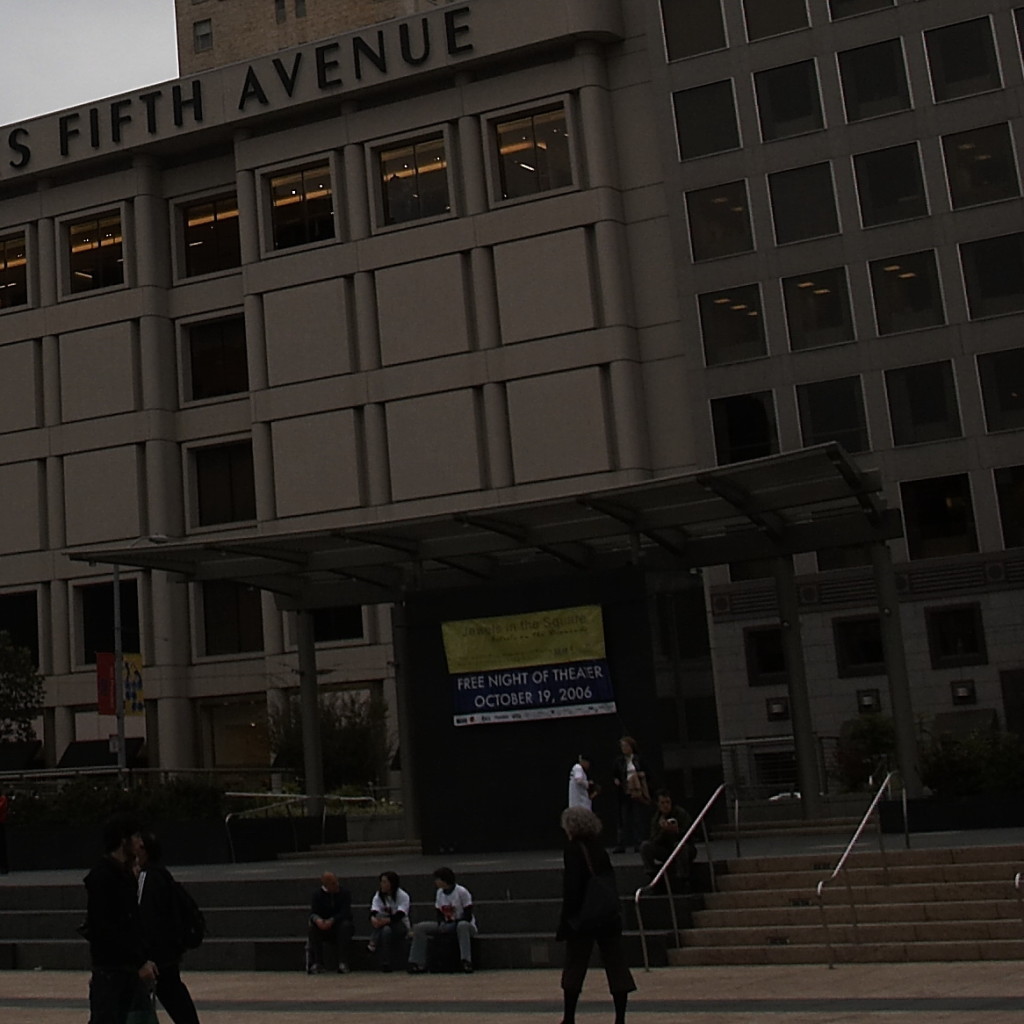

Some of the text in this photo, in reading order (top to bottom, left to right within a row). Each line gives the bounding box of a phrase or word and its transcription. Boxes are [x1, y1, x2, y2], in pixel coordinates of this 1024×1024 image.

[58, 80, 204, 156] FIFTH
[238, 6, 473, 110] AVENUE
[457, 676, 485, 692] FREE
[488, 671, 528, 688] NIGHT
[531, 670, 550, 684] OF
[474, 685, 593, 708] OCTOBER 19, 2006
